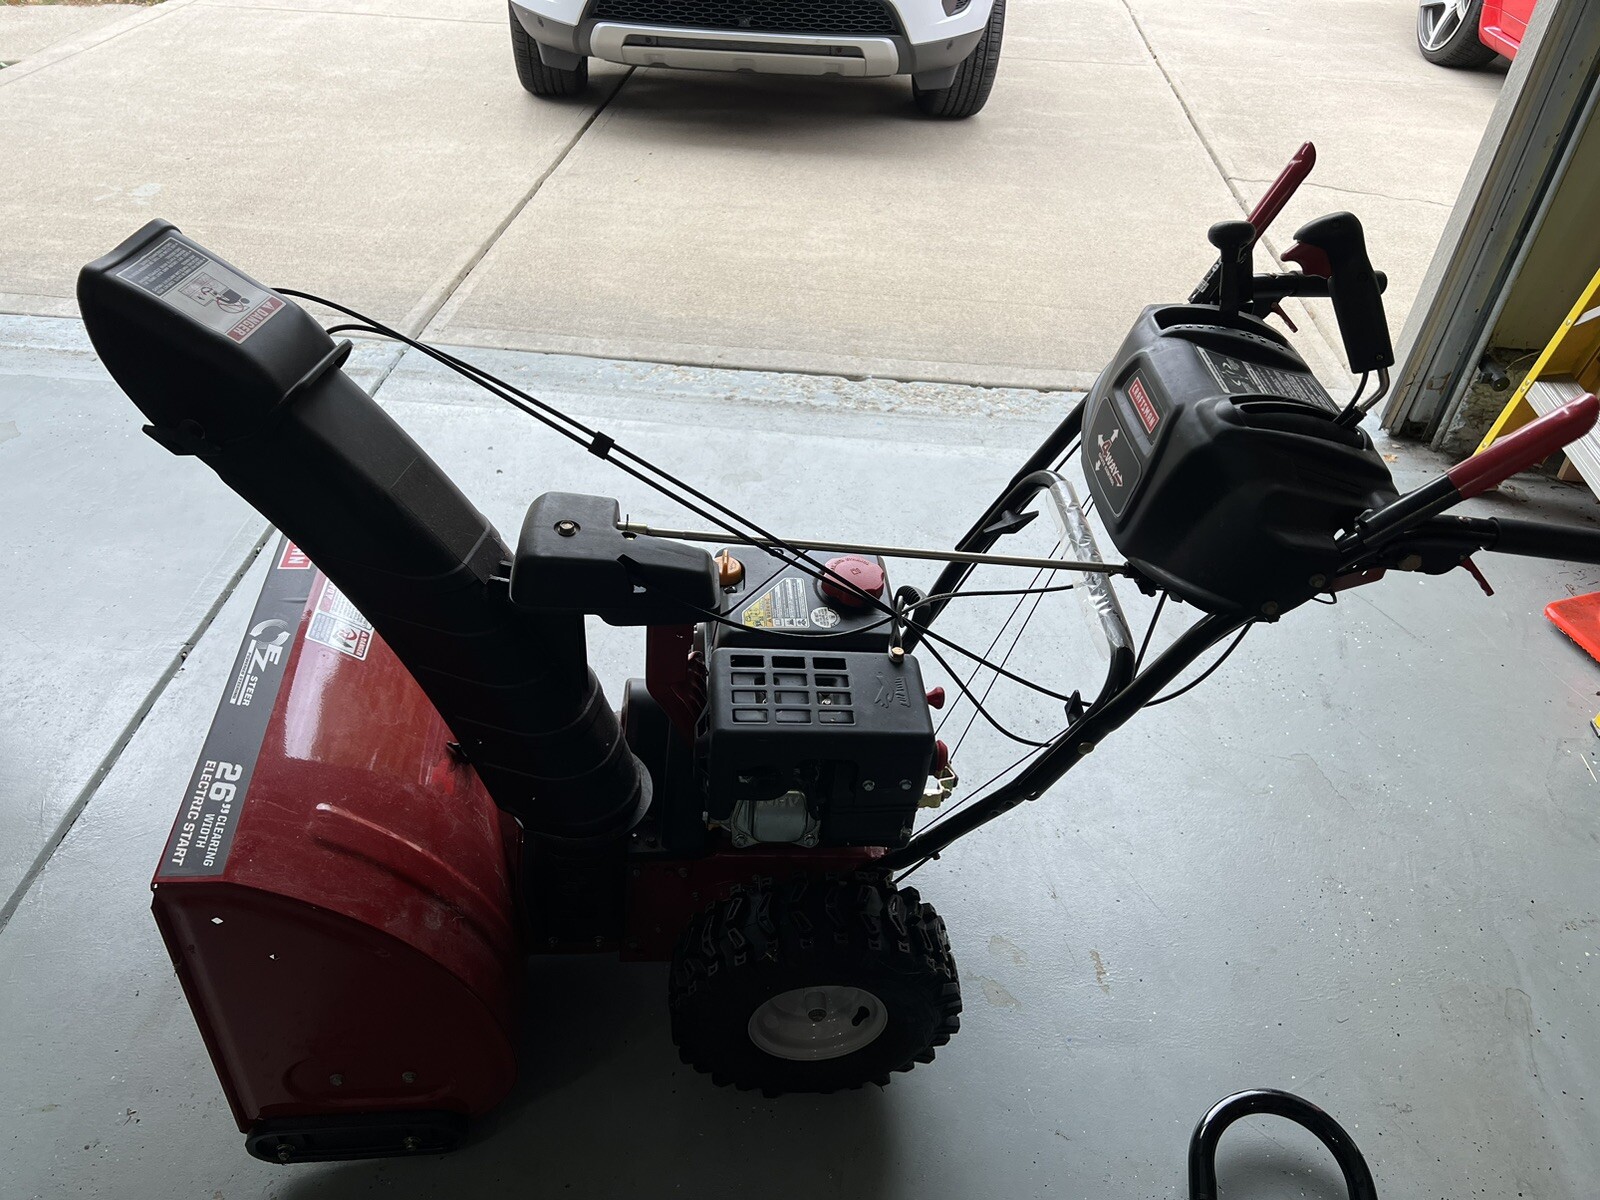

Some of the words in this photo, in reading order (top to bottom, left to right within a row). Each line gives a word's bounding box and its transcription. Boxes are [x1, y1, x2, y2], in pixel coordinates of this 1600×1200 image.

[232, 308, 269, 337] DANGER
[1131, 383, 1156, 428] CRAFTSMAN
[247, 643, 284, 675] EZ
[241, 675, 259, 707] STEER
[187, 760, 217, 820] ELECTRIC
[171, 822, 196, 867] START
[195, 813, 216, 849] WIDTH
[202, 814, 228, 867] CLEARING
